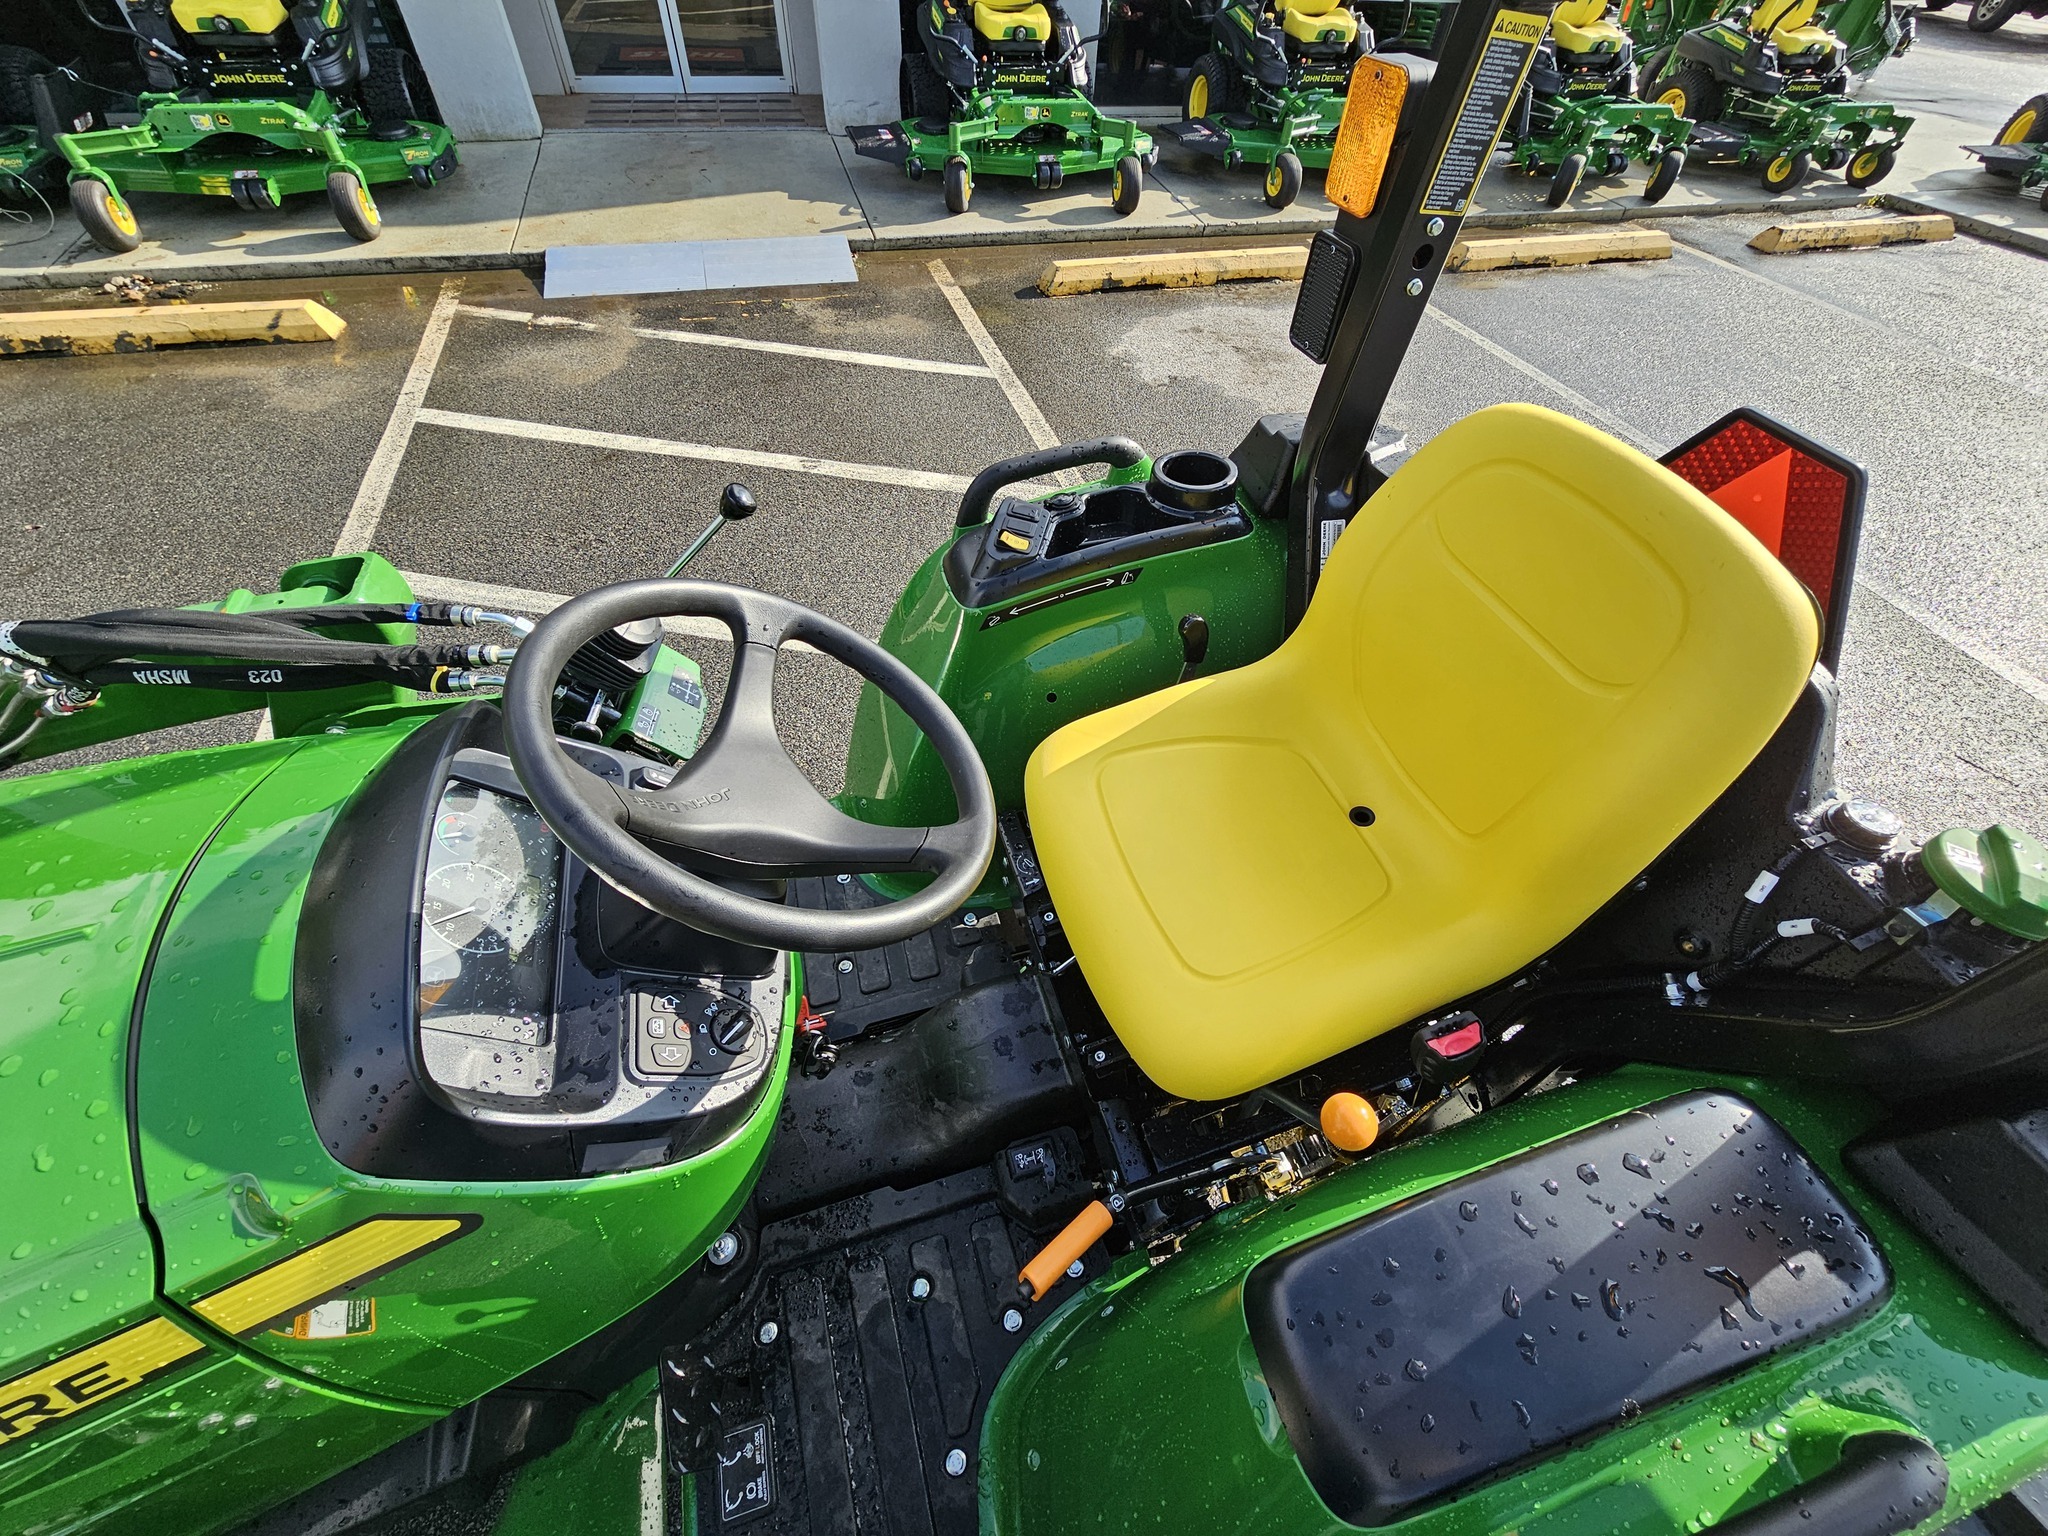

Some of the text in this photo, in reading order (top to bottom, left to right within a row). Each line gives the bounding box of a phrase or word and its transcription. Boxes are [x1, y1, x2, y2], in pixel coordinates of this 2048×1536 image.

[1505, 21, 1542, 38] CAUTION
[214, 73, 286, 84] JOHN DEERE
[995, 74, 1046, 82] JOHN DEERE
[1300, 74, 1345, 82] JOHN DEERE
[1568, 82, 1586, 90] JOHN
[132, 669, 283, 684] 023 MSHA
[681, 788, 731, 811] JOHN
[466, 872, 475, 882] 25
[442, 878, 450, 888] 20
[433, 902, 442, 910] 15
[446, 922, 455, 934] 10
